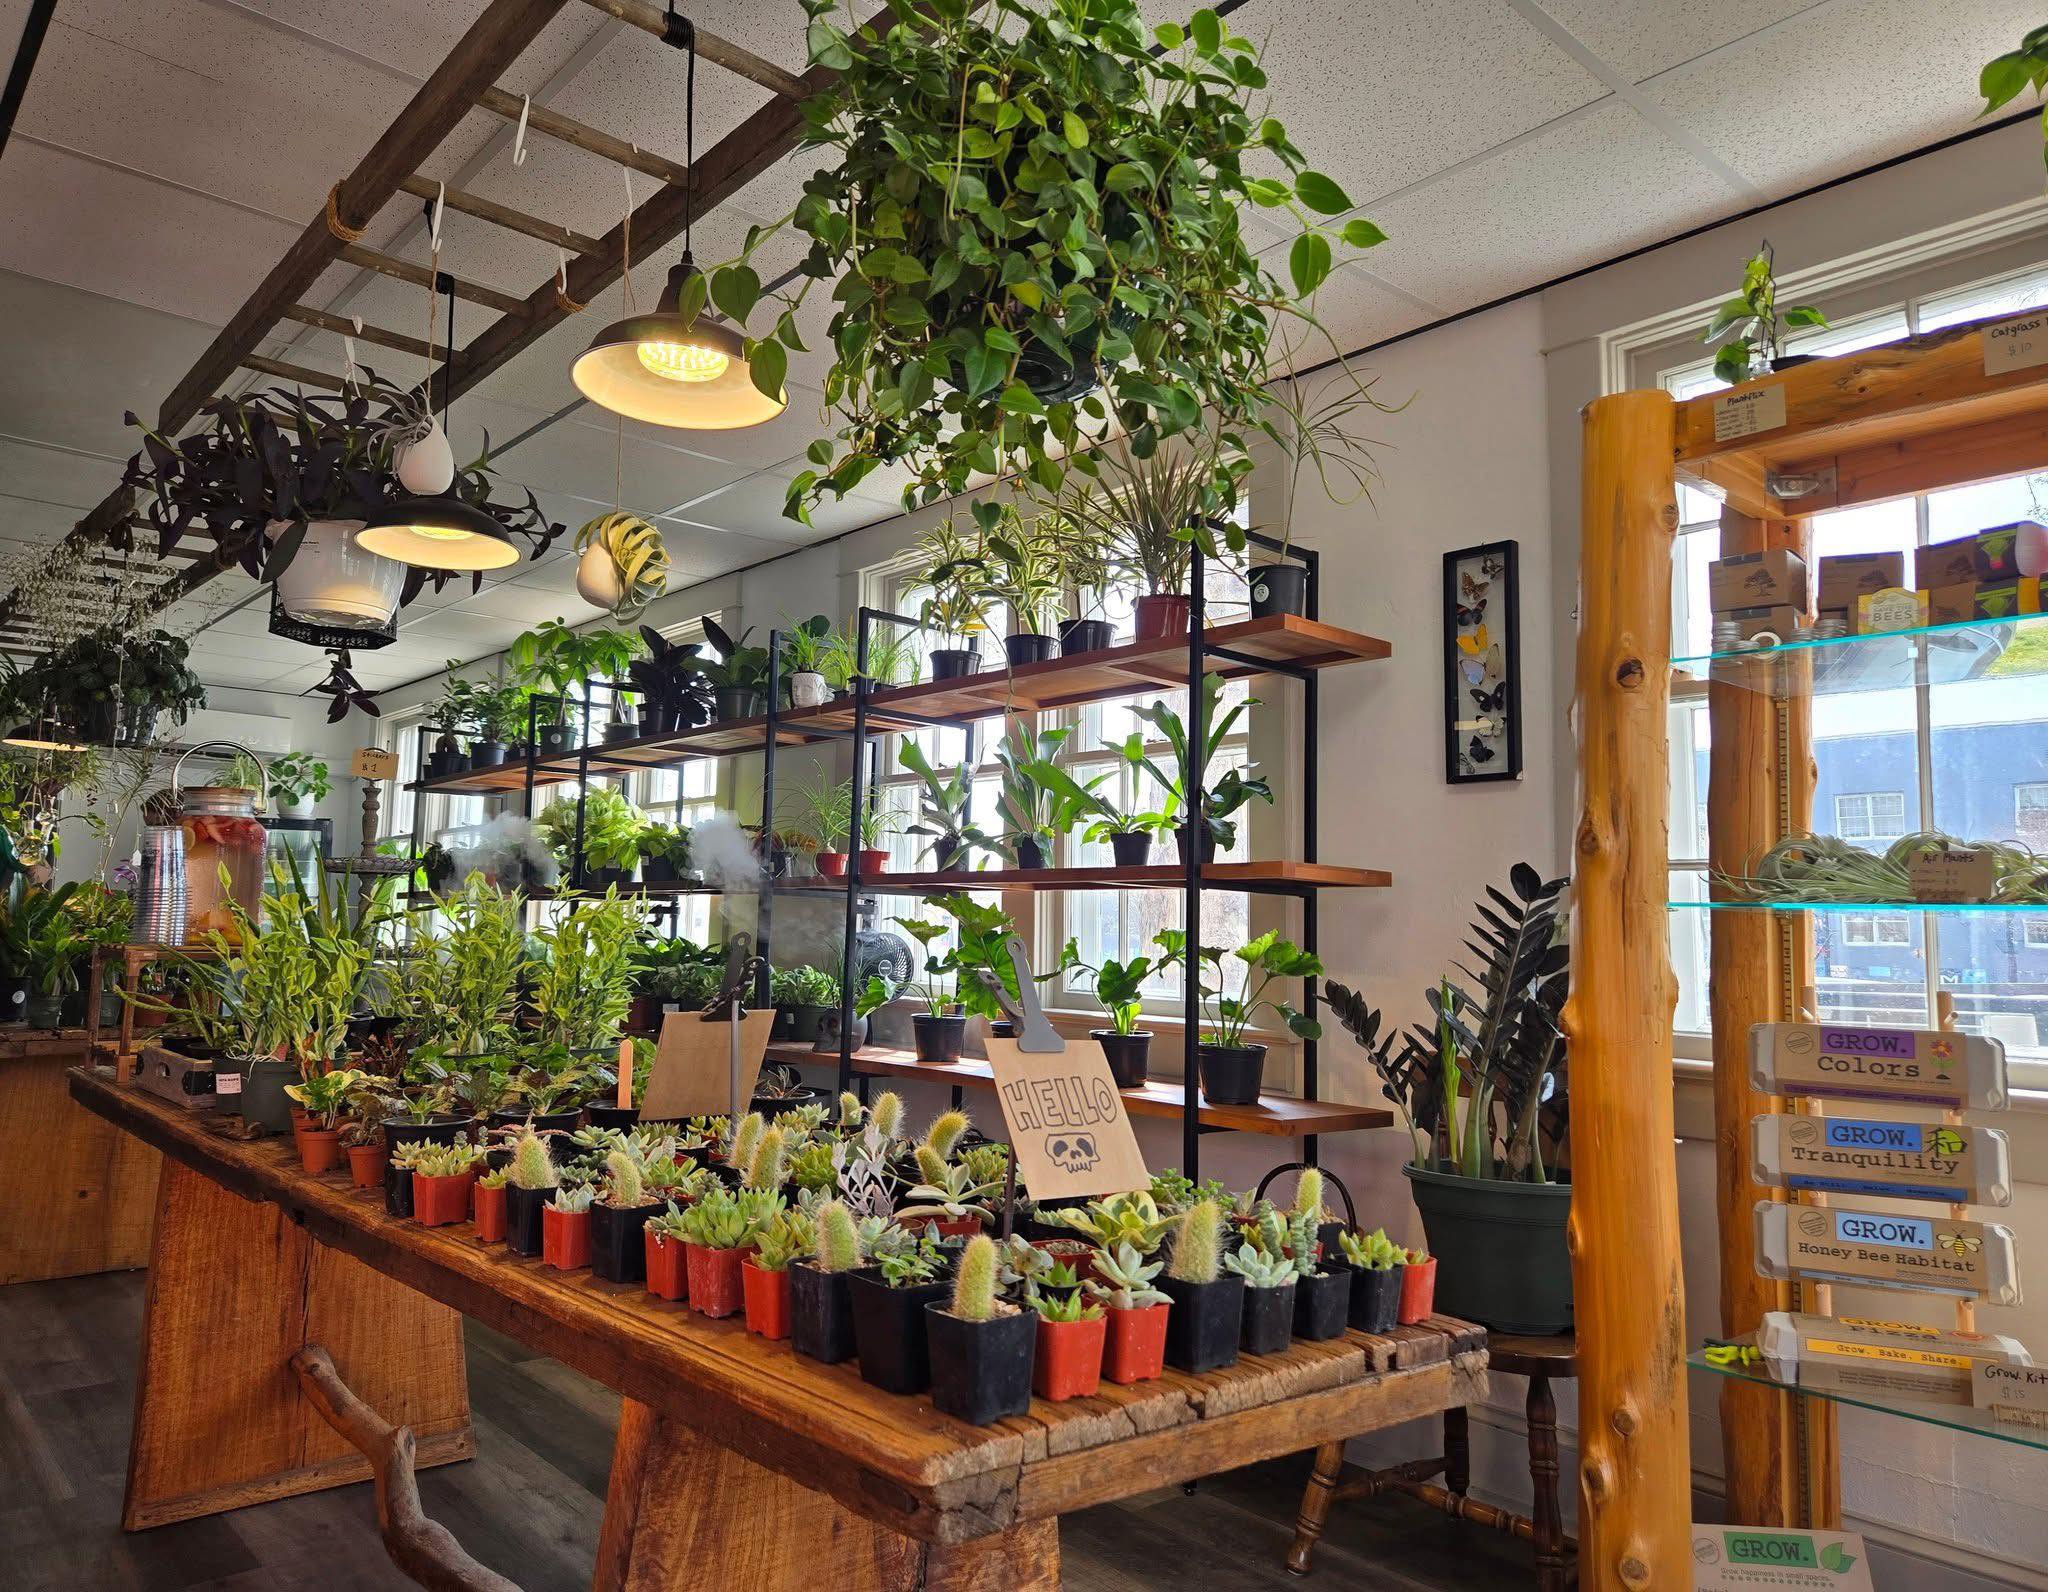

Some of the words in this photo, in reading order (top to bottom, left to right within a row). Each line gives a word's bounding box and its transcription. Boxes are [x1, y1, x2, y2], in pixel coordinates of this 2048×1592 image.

[1991, 319, 2041, 338] Catgrass
[1873, 610, 1912, 621] BEES
[1826, 1033, 1907, 1053] GROW.
[1818, 1056, 1920, 1077] Colors
[1002, 1076, 1117, 1132] HELLO
[1832, 1125, 1914, 1147] GROW.
[1791, 1146, 1960, 1174] Tranquility
[1842, 1219, 1925, 1245] GROW.
[1798, 1242, 1852, 1260] Honey
[1858, 1249, 1890, 1262] Bee
[1896, 1253, 1976, 1273] Habitat
[1836, 1343, 1871, 1355] Grow.
[1921, 1353, 1963, 1366] Share.
[2026, 1371, 2048, 1385] Kit
[1731, 1538, 1809, 1562] GROW.
[1720, 1567, 1739, 1575] Grow
[1740, 1568, 1775, 1577] happiness
